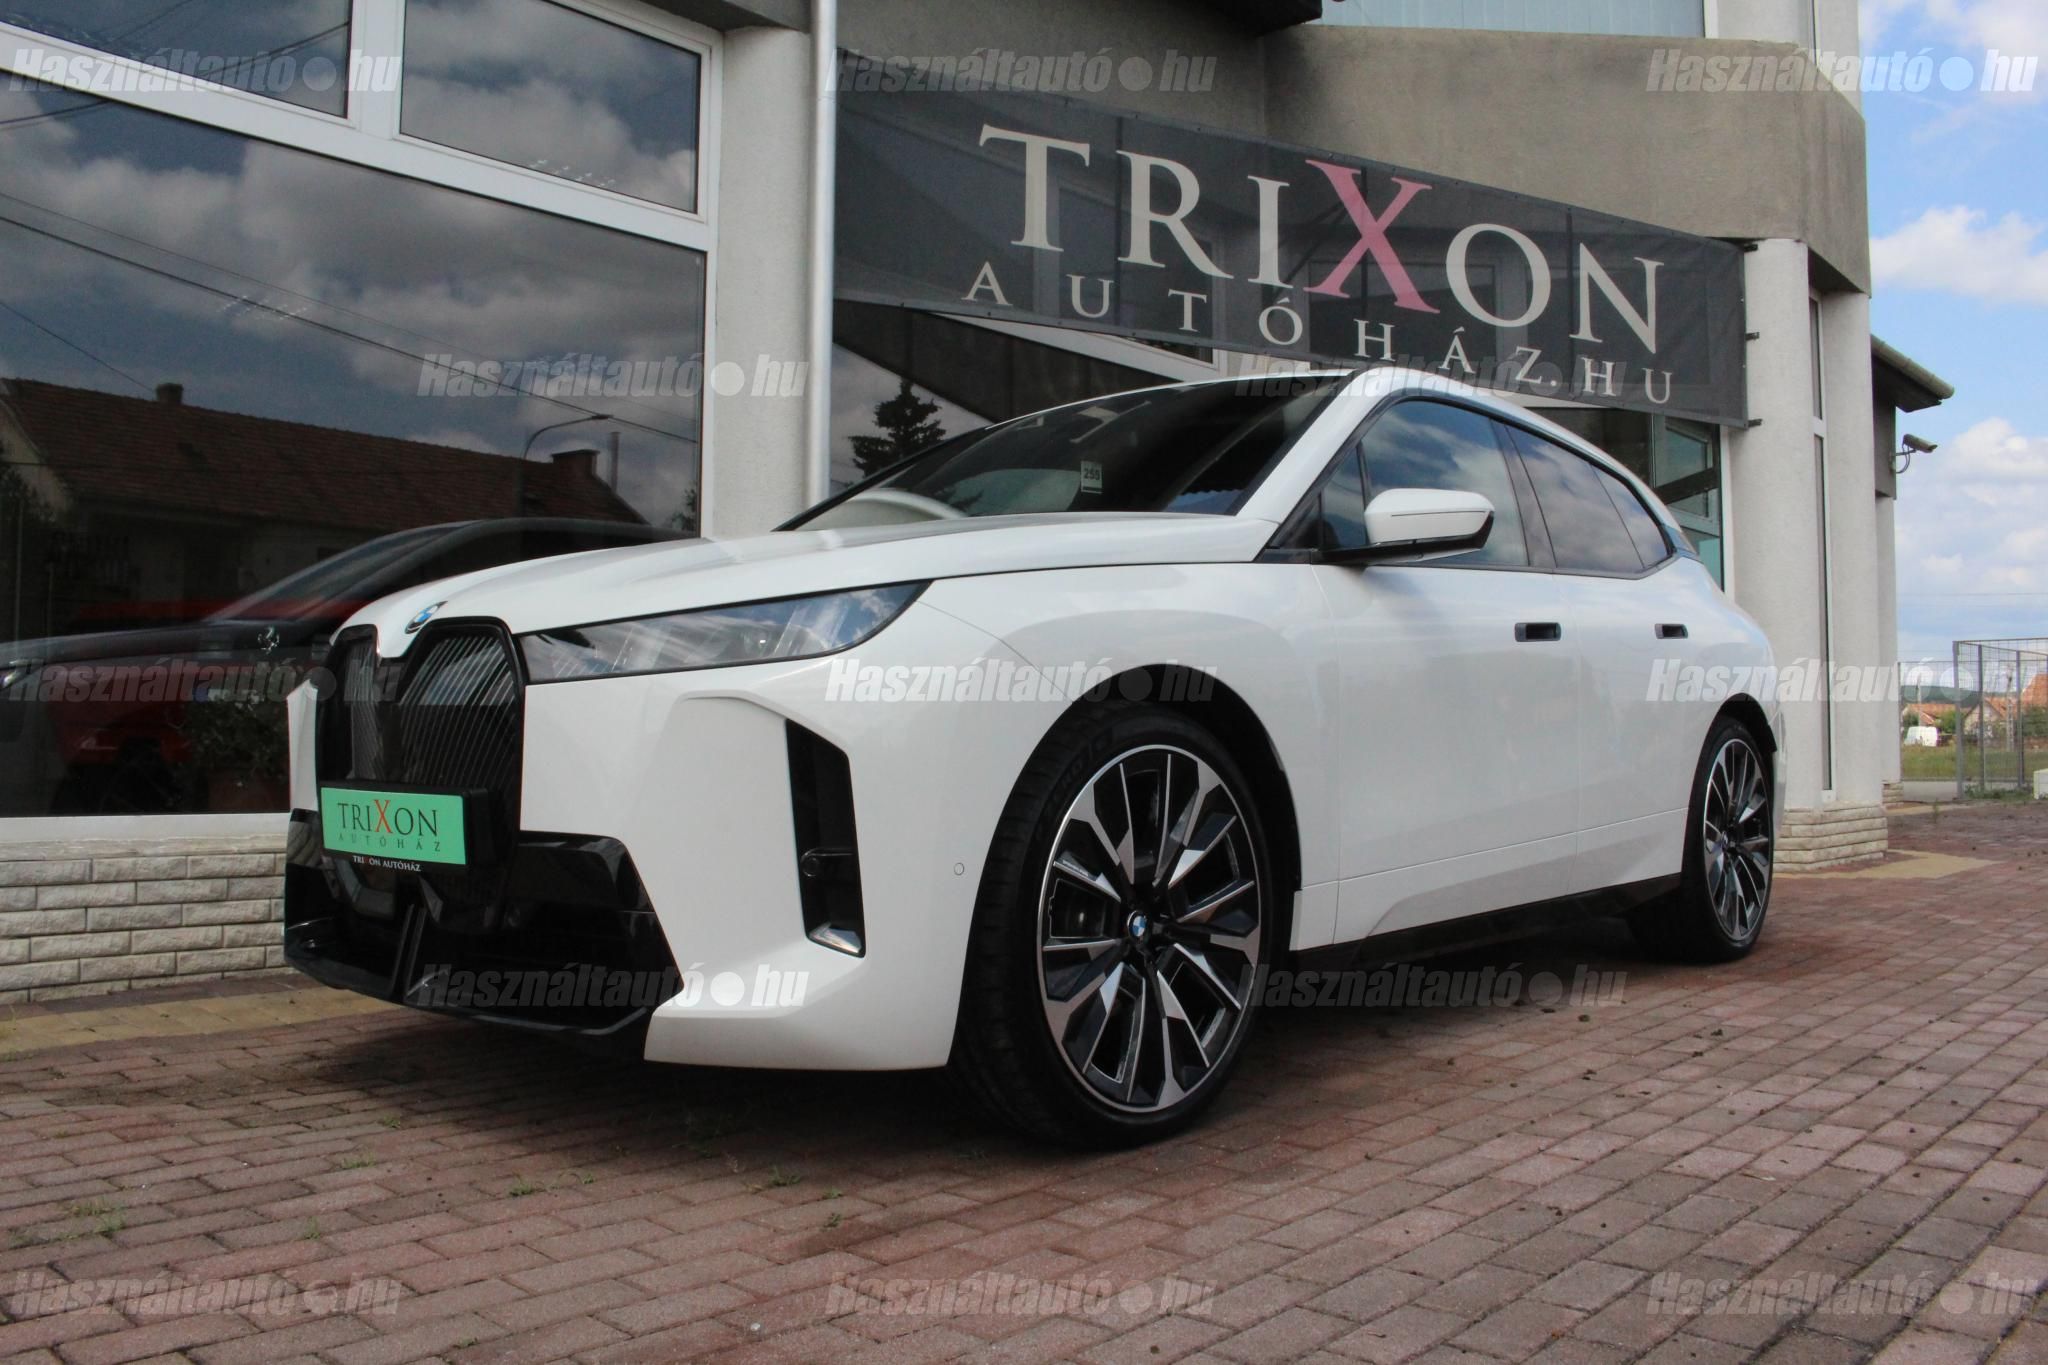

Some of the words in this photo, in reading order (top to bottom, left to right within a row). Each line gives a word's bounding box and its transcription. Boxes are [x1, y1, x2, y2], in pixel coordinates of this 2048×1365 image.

[978, 125, 1664, 354] TRIXON
[337, 799, 438, 837] TRIXON
[338, 833, 440, 852] AUTÓHÁZ
